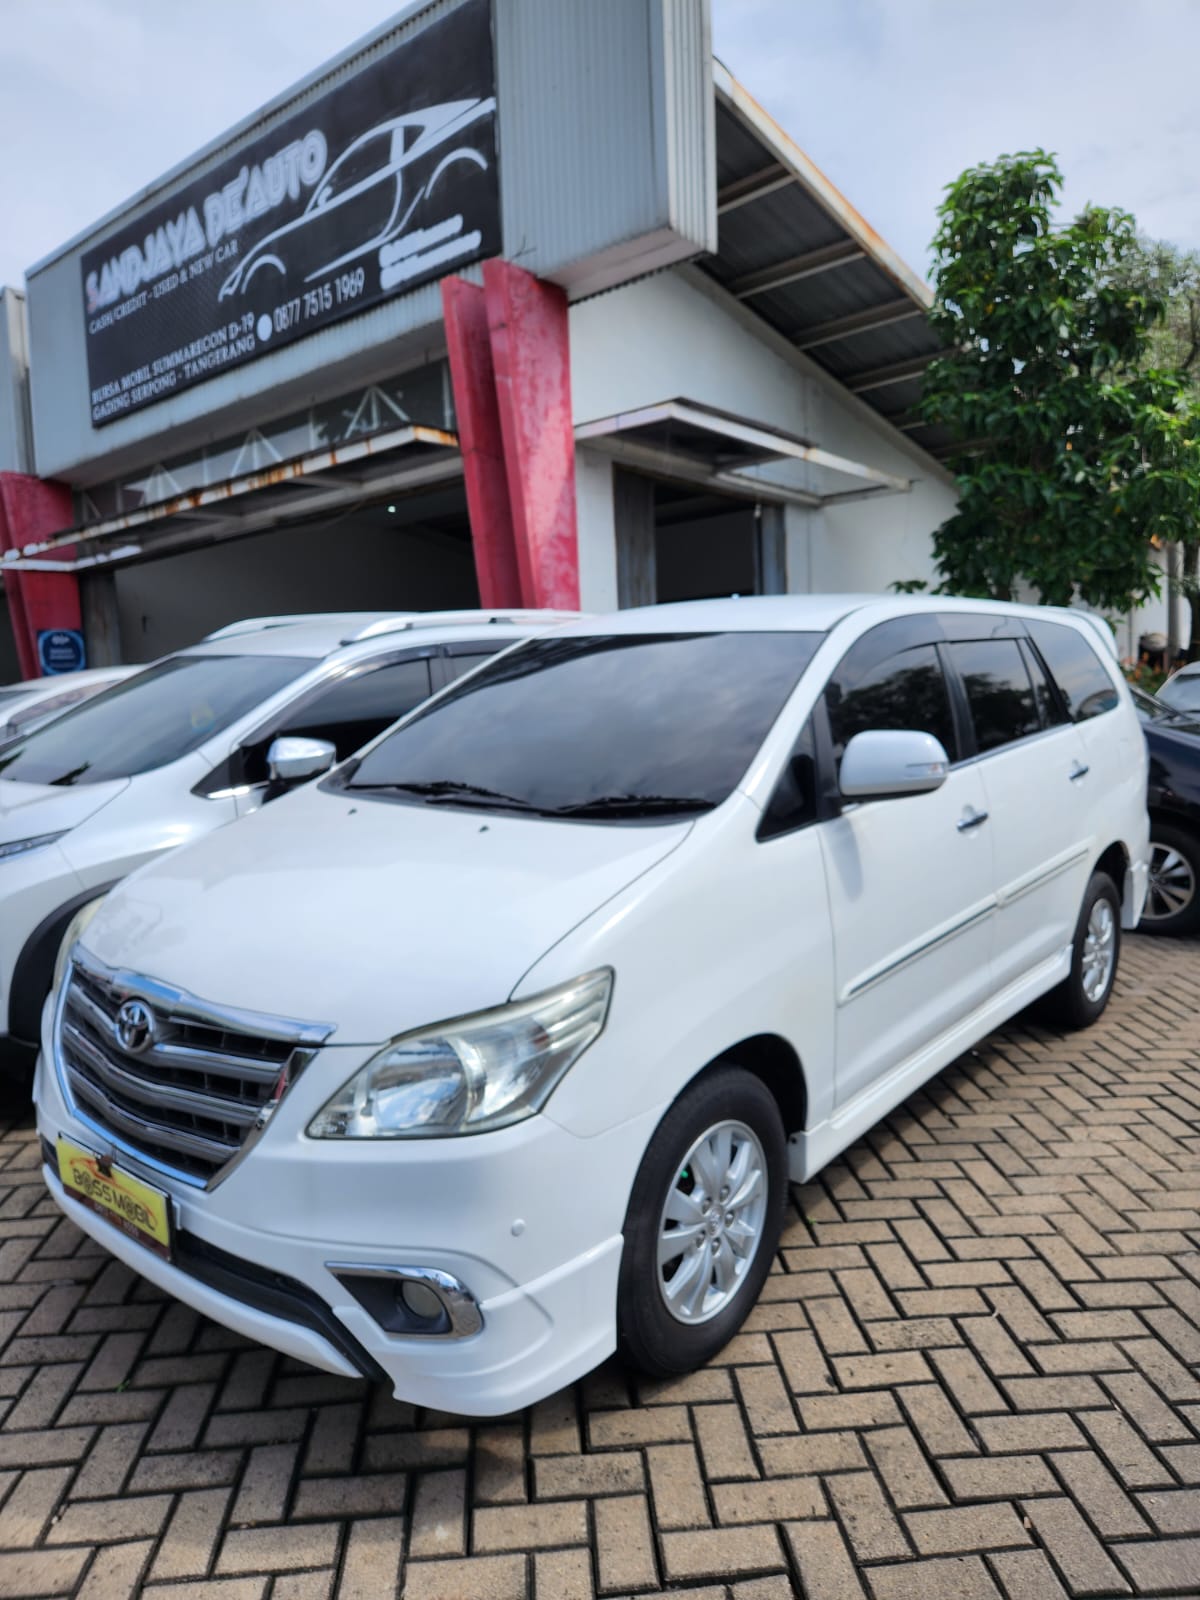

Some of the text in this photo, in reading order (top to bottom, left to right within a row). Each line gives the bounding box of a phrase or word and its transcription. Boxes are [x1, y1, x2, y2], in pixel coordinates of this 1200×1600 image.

[273, 297, 301, 333] 0877
[302, 282, 333, 319] 7515
[184, 333, 256, 379] TANGERANG
